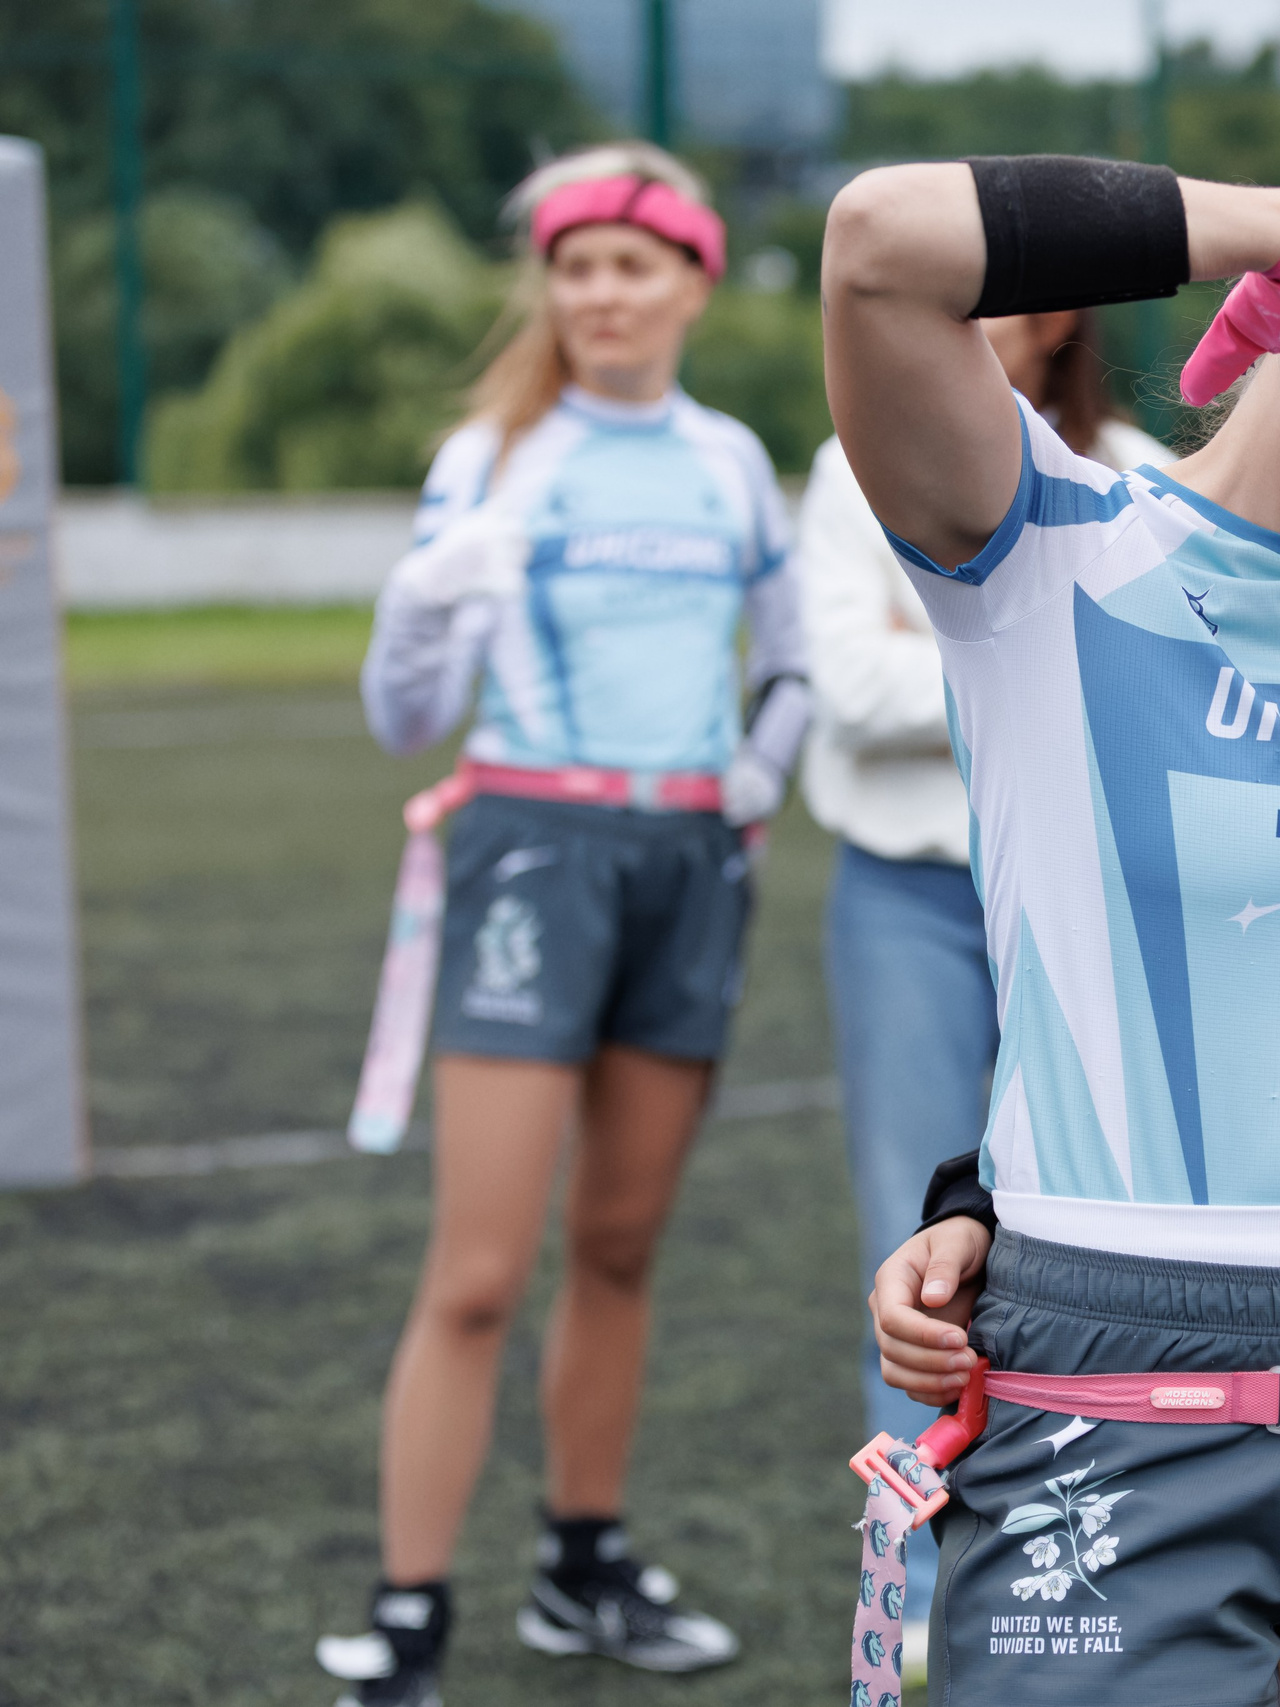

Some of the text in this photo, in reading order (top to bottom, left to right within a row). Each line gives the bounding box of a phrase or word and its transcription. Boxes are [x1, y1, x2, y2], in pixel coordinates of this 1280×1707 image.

[1164, 1390, 1211, 1398] MOSCOW
[1160, 1398, 1214, 1406] UNICORNS
[991, 1616, 1123, 1634] UNITED WE RISE,
[989, 1635, 1124, 1654] DIVIDED WE FALL
